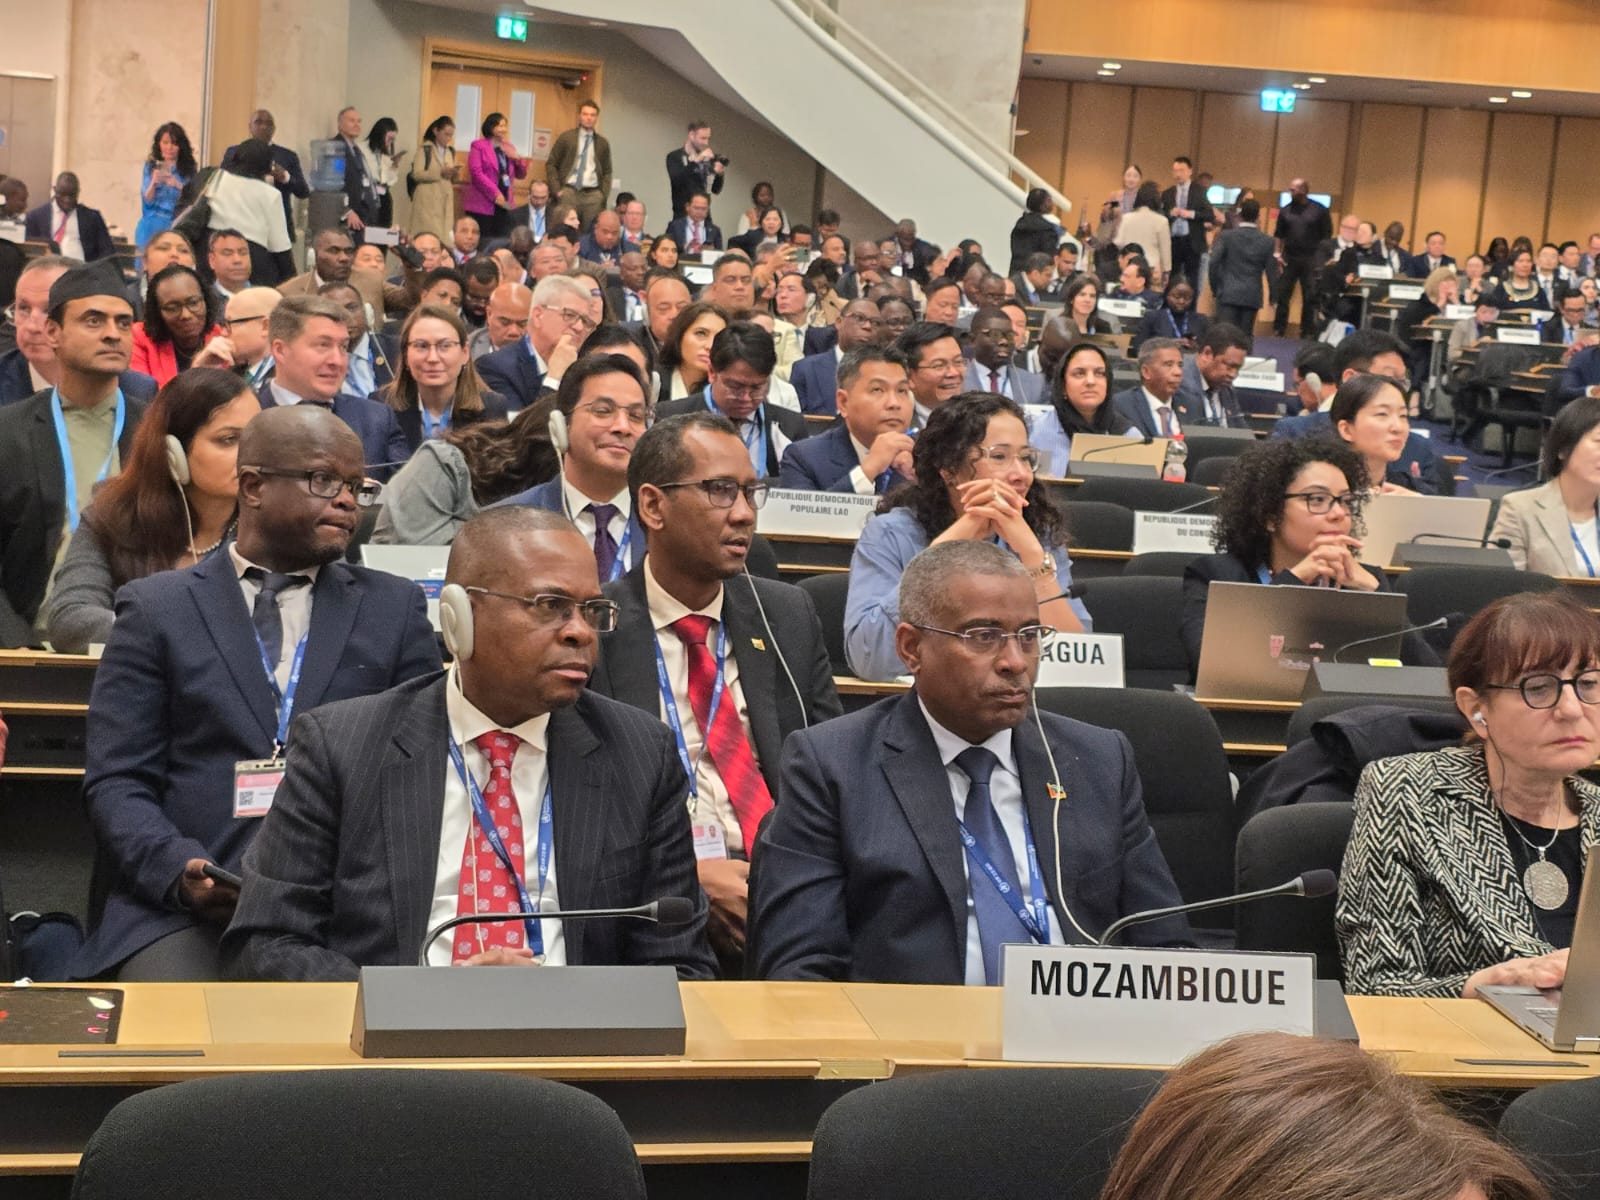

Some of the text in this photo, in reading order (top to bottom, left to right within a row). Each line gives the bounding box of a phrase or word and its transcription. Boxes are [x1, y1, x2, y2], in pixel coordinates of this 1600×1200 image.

[790, 504, 849, 516] POPULAIRE LAO
[1143, 514, 1188, 525] REPUBLIQUE
[1177, 528, 1188, 537] DU
[1030, 959, 1286, 1006] MOZAMBIQUE
